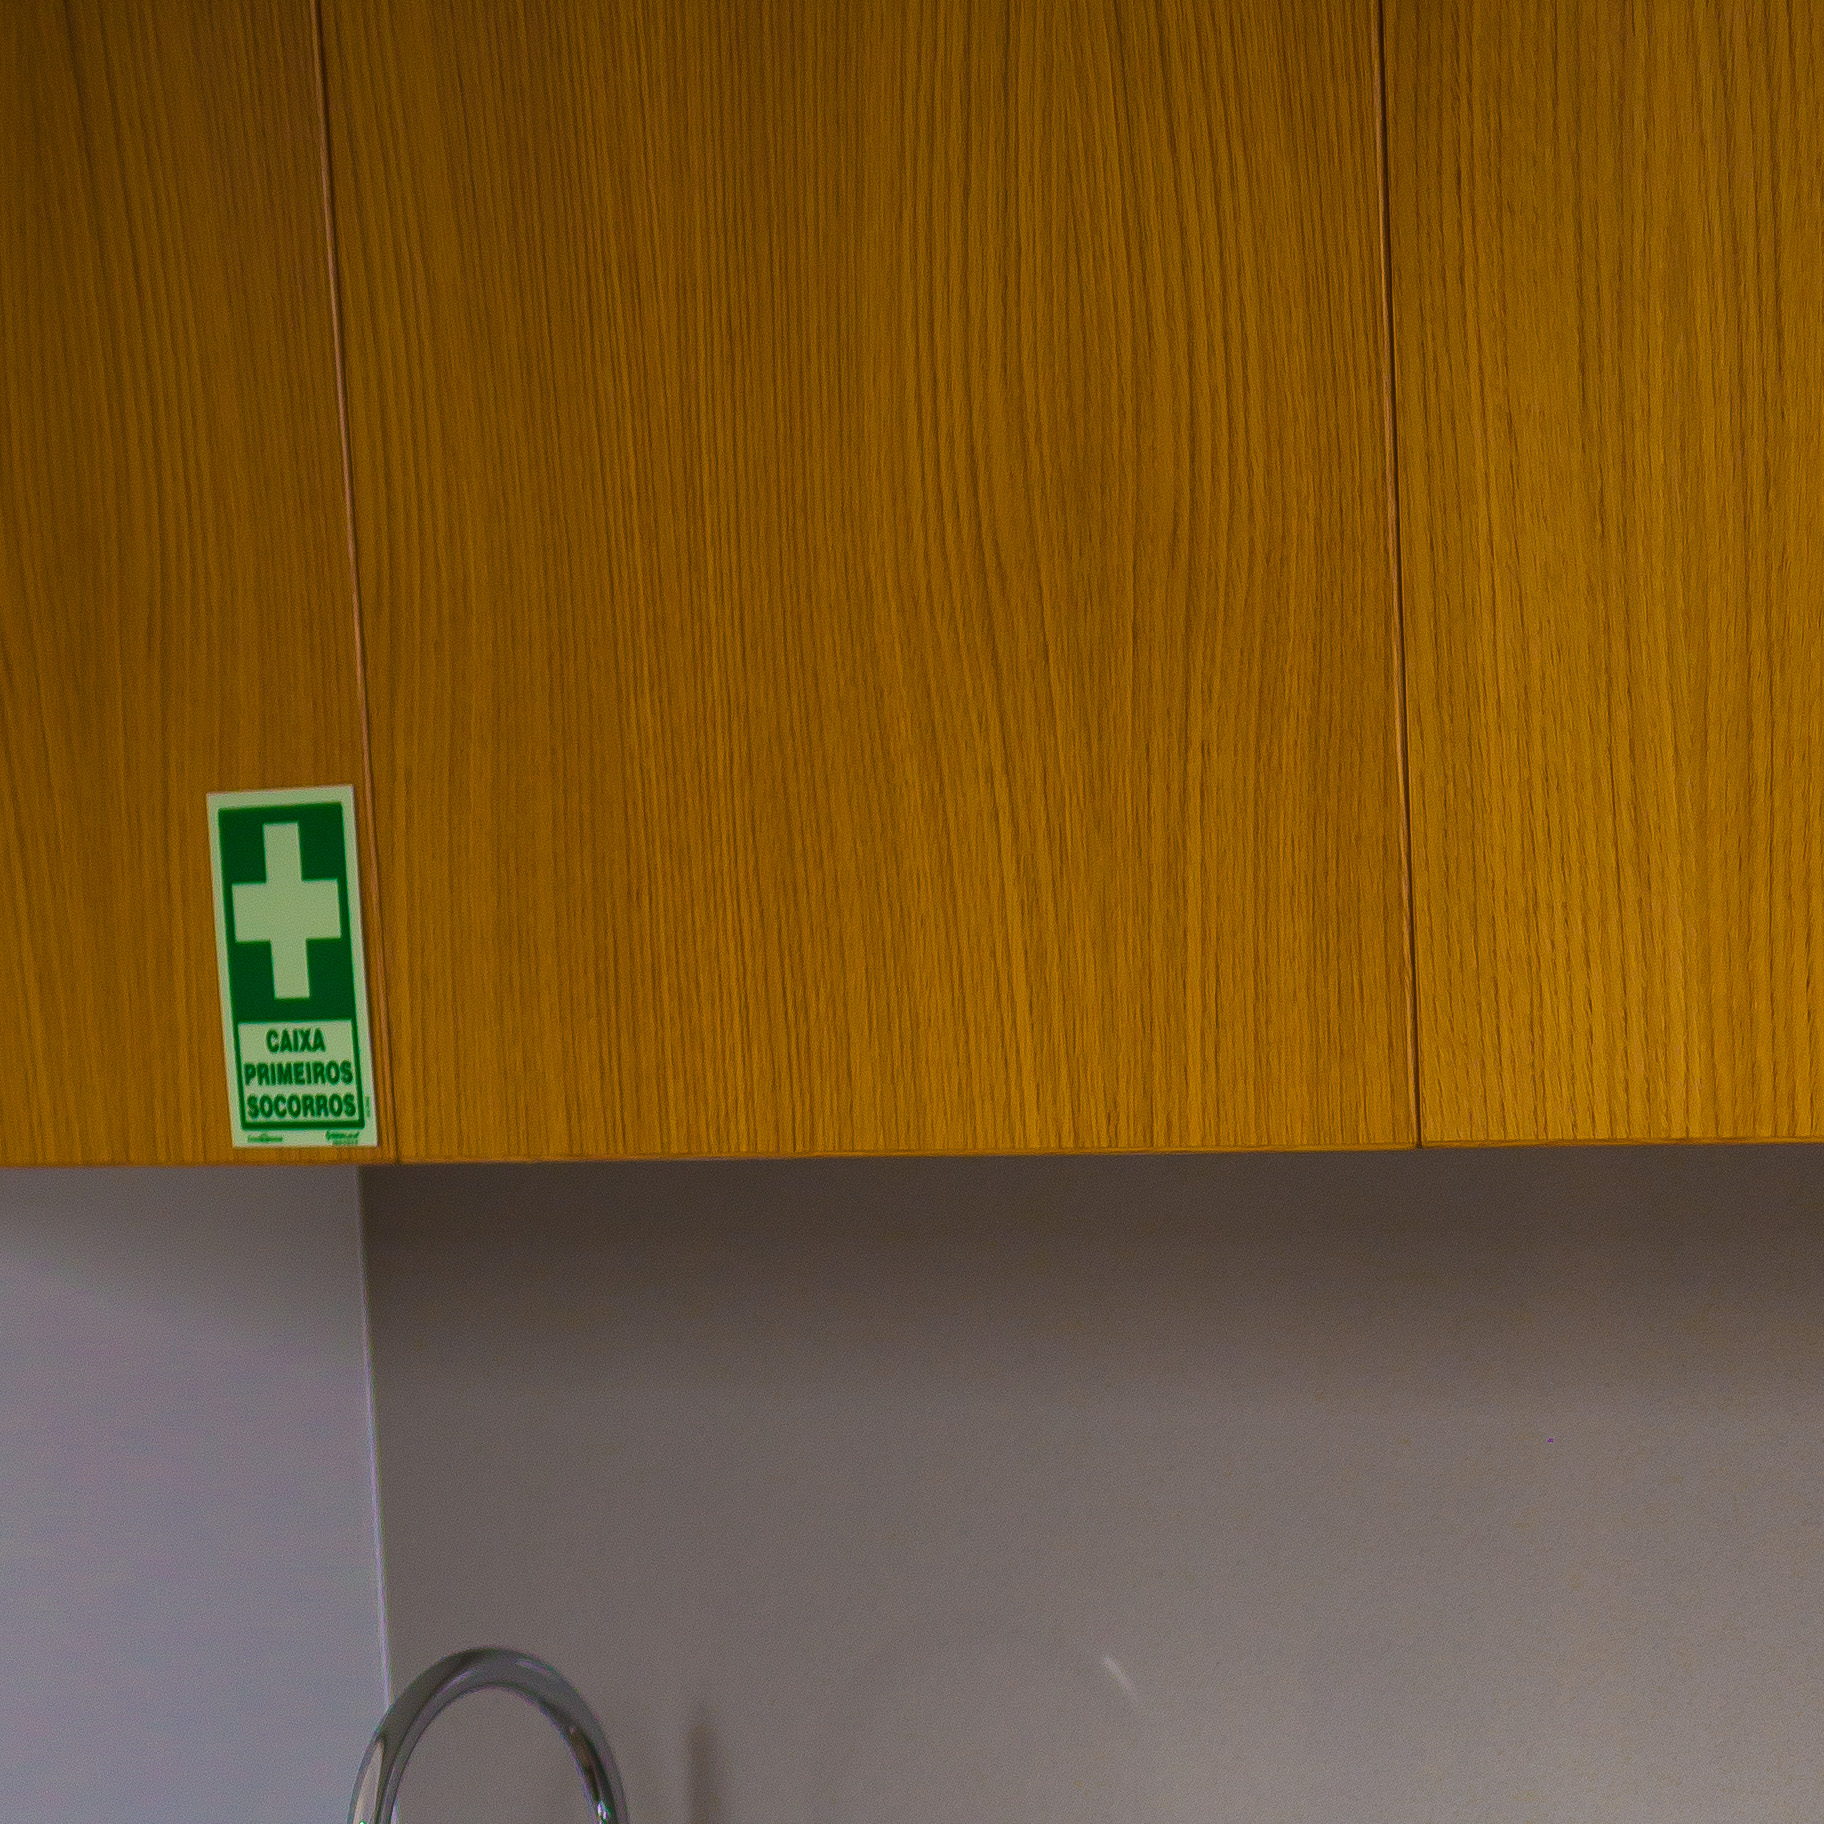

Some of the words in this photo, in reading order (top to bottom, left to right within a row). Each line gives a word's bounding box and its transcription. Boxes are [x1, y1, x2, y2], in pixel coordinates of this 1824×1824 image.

[265, 1027, 327, 1053] CAIXA
[243, 1060, 354, 1086] PRIMEIROS
[246, 1092, 357, 1119] SOCORROS
